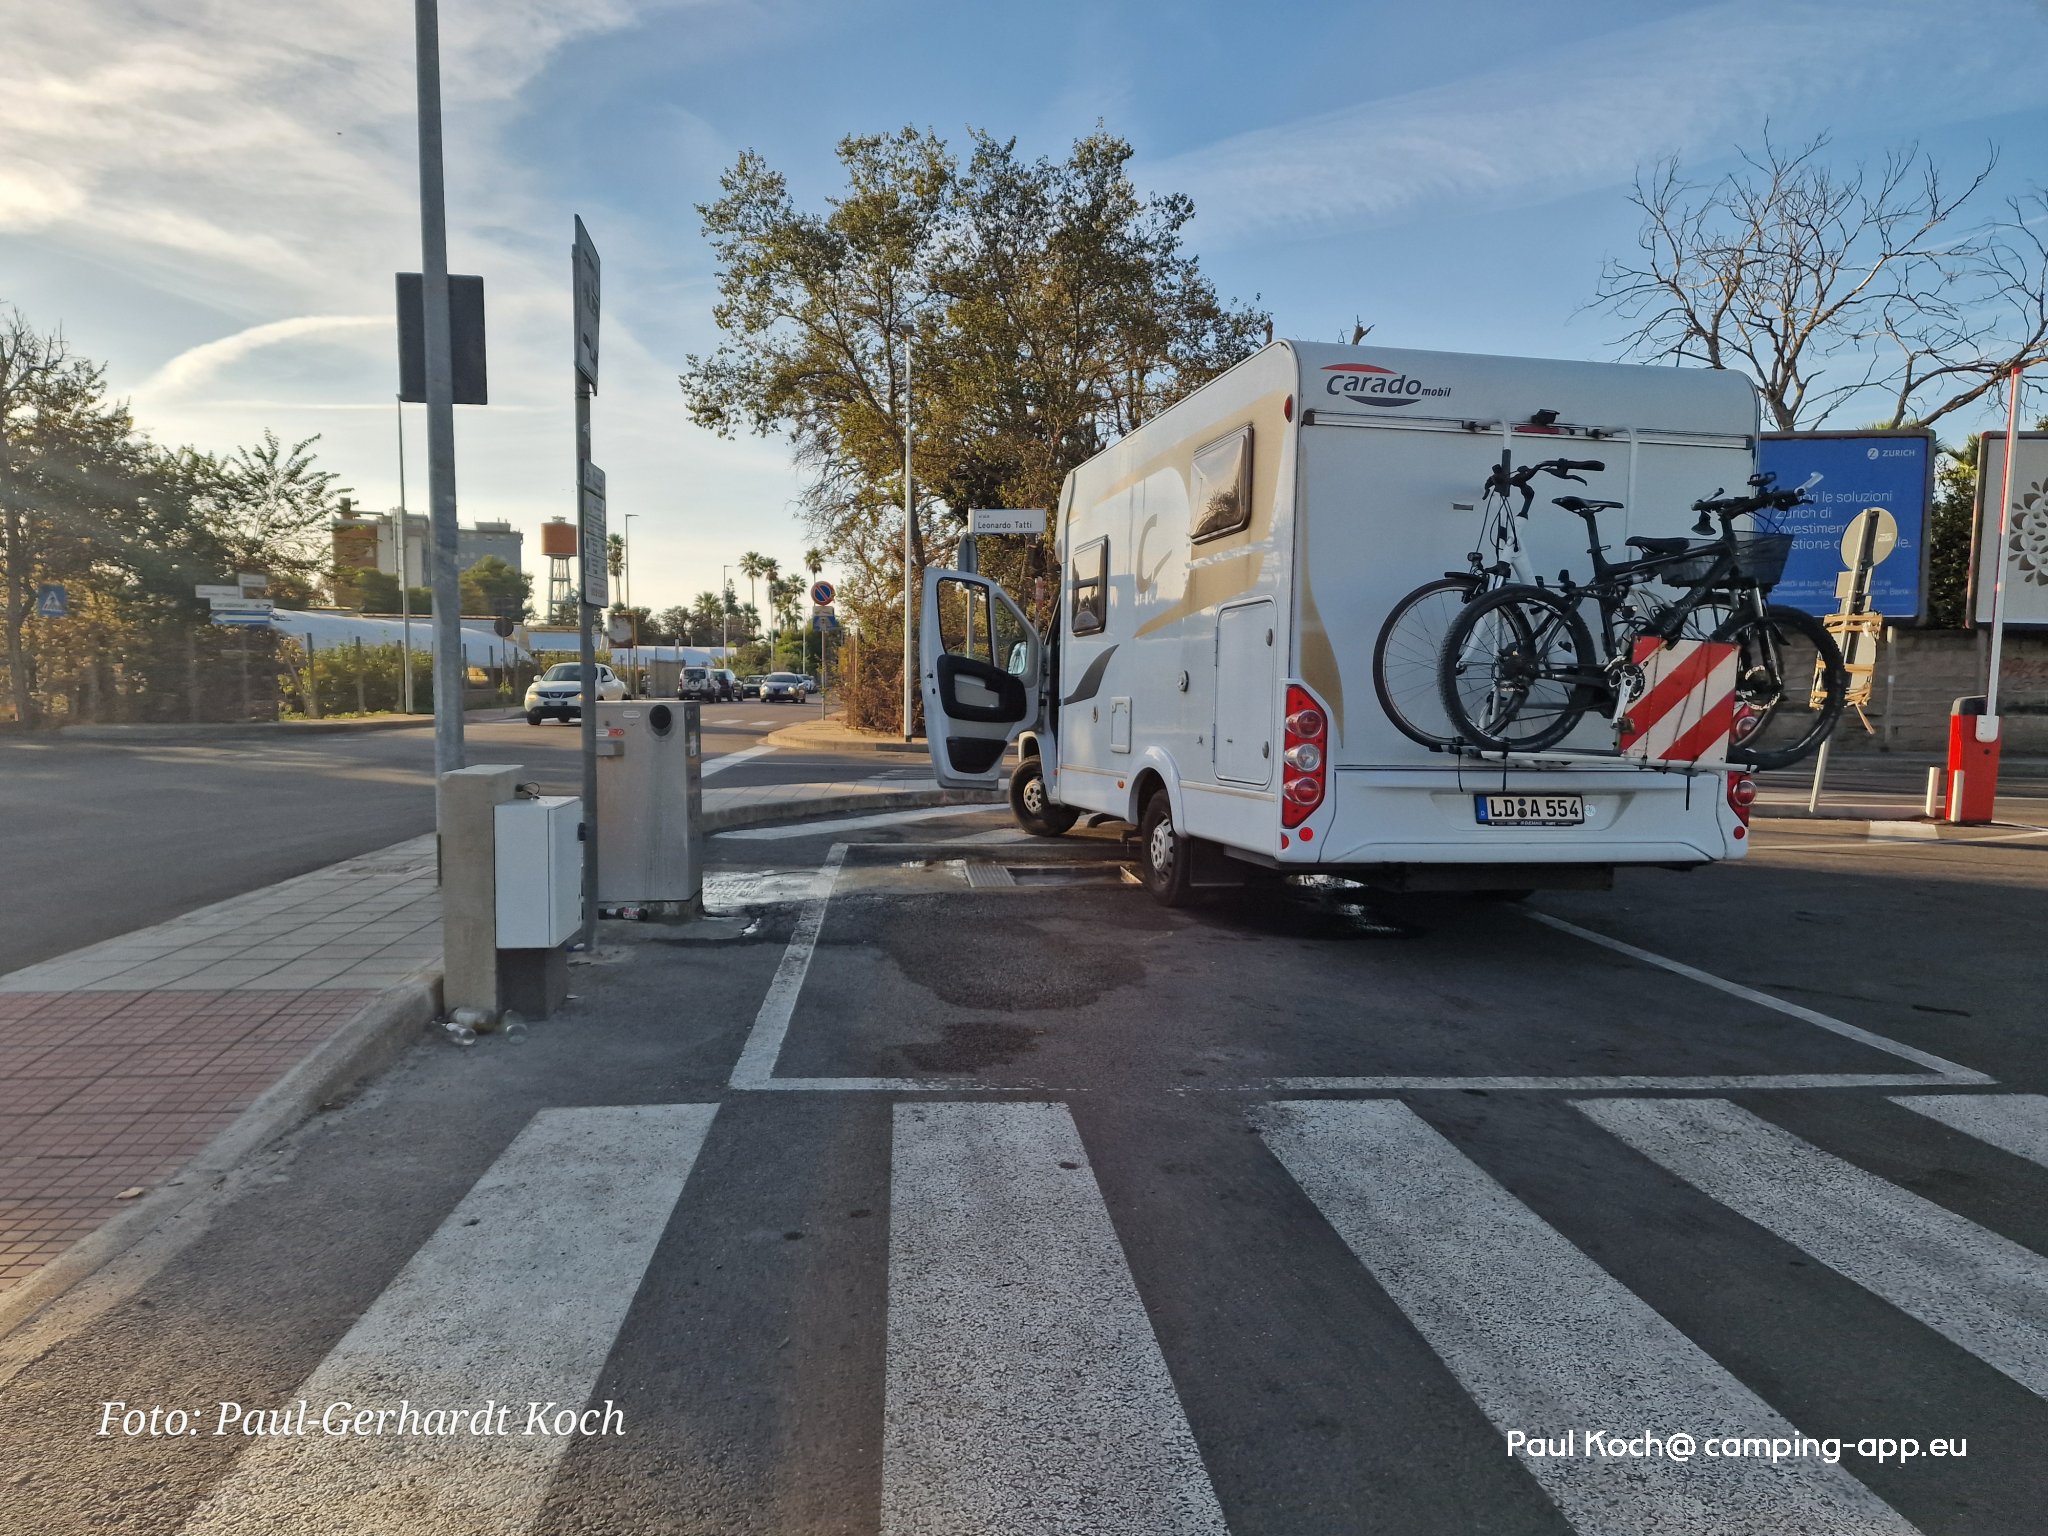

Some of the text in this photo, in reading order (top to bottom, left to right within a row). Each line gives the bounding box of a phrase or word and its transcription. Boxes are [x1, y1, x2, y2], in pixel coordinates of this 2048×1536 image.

[1421, 387, 1452, 398] mobil
[1882, 449, 1916, 458] ZURICH
[1822, 491, 1833, 502] le
[1836, 490, 1894, 503] soluzioni
[1819, 507, 1832, 519] di
[977, 521, 1032, 529] Leonardo Tatti
[1791, 538, 1831, 550] stione
[1490, 799, 1515, 818] LD
[1530, 799, 1541, 818] A
[1545, 799, 1579, 818] 554
